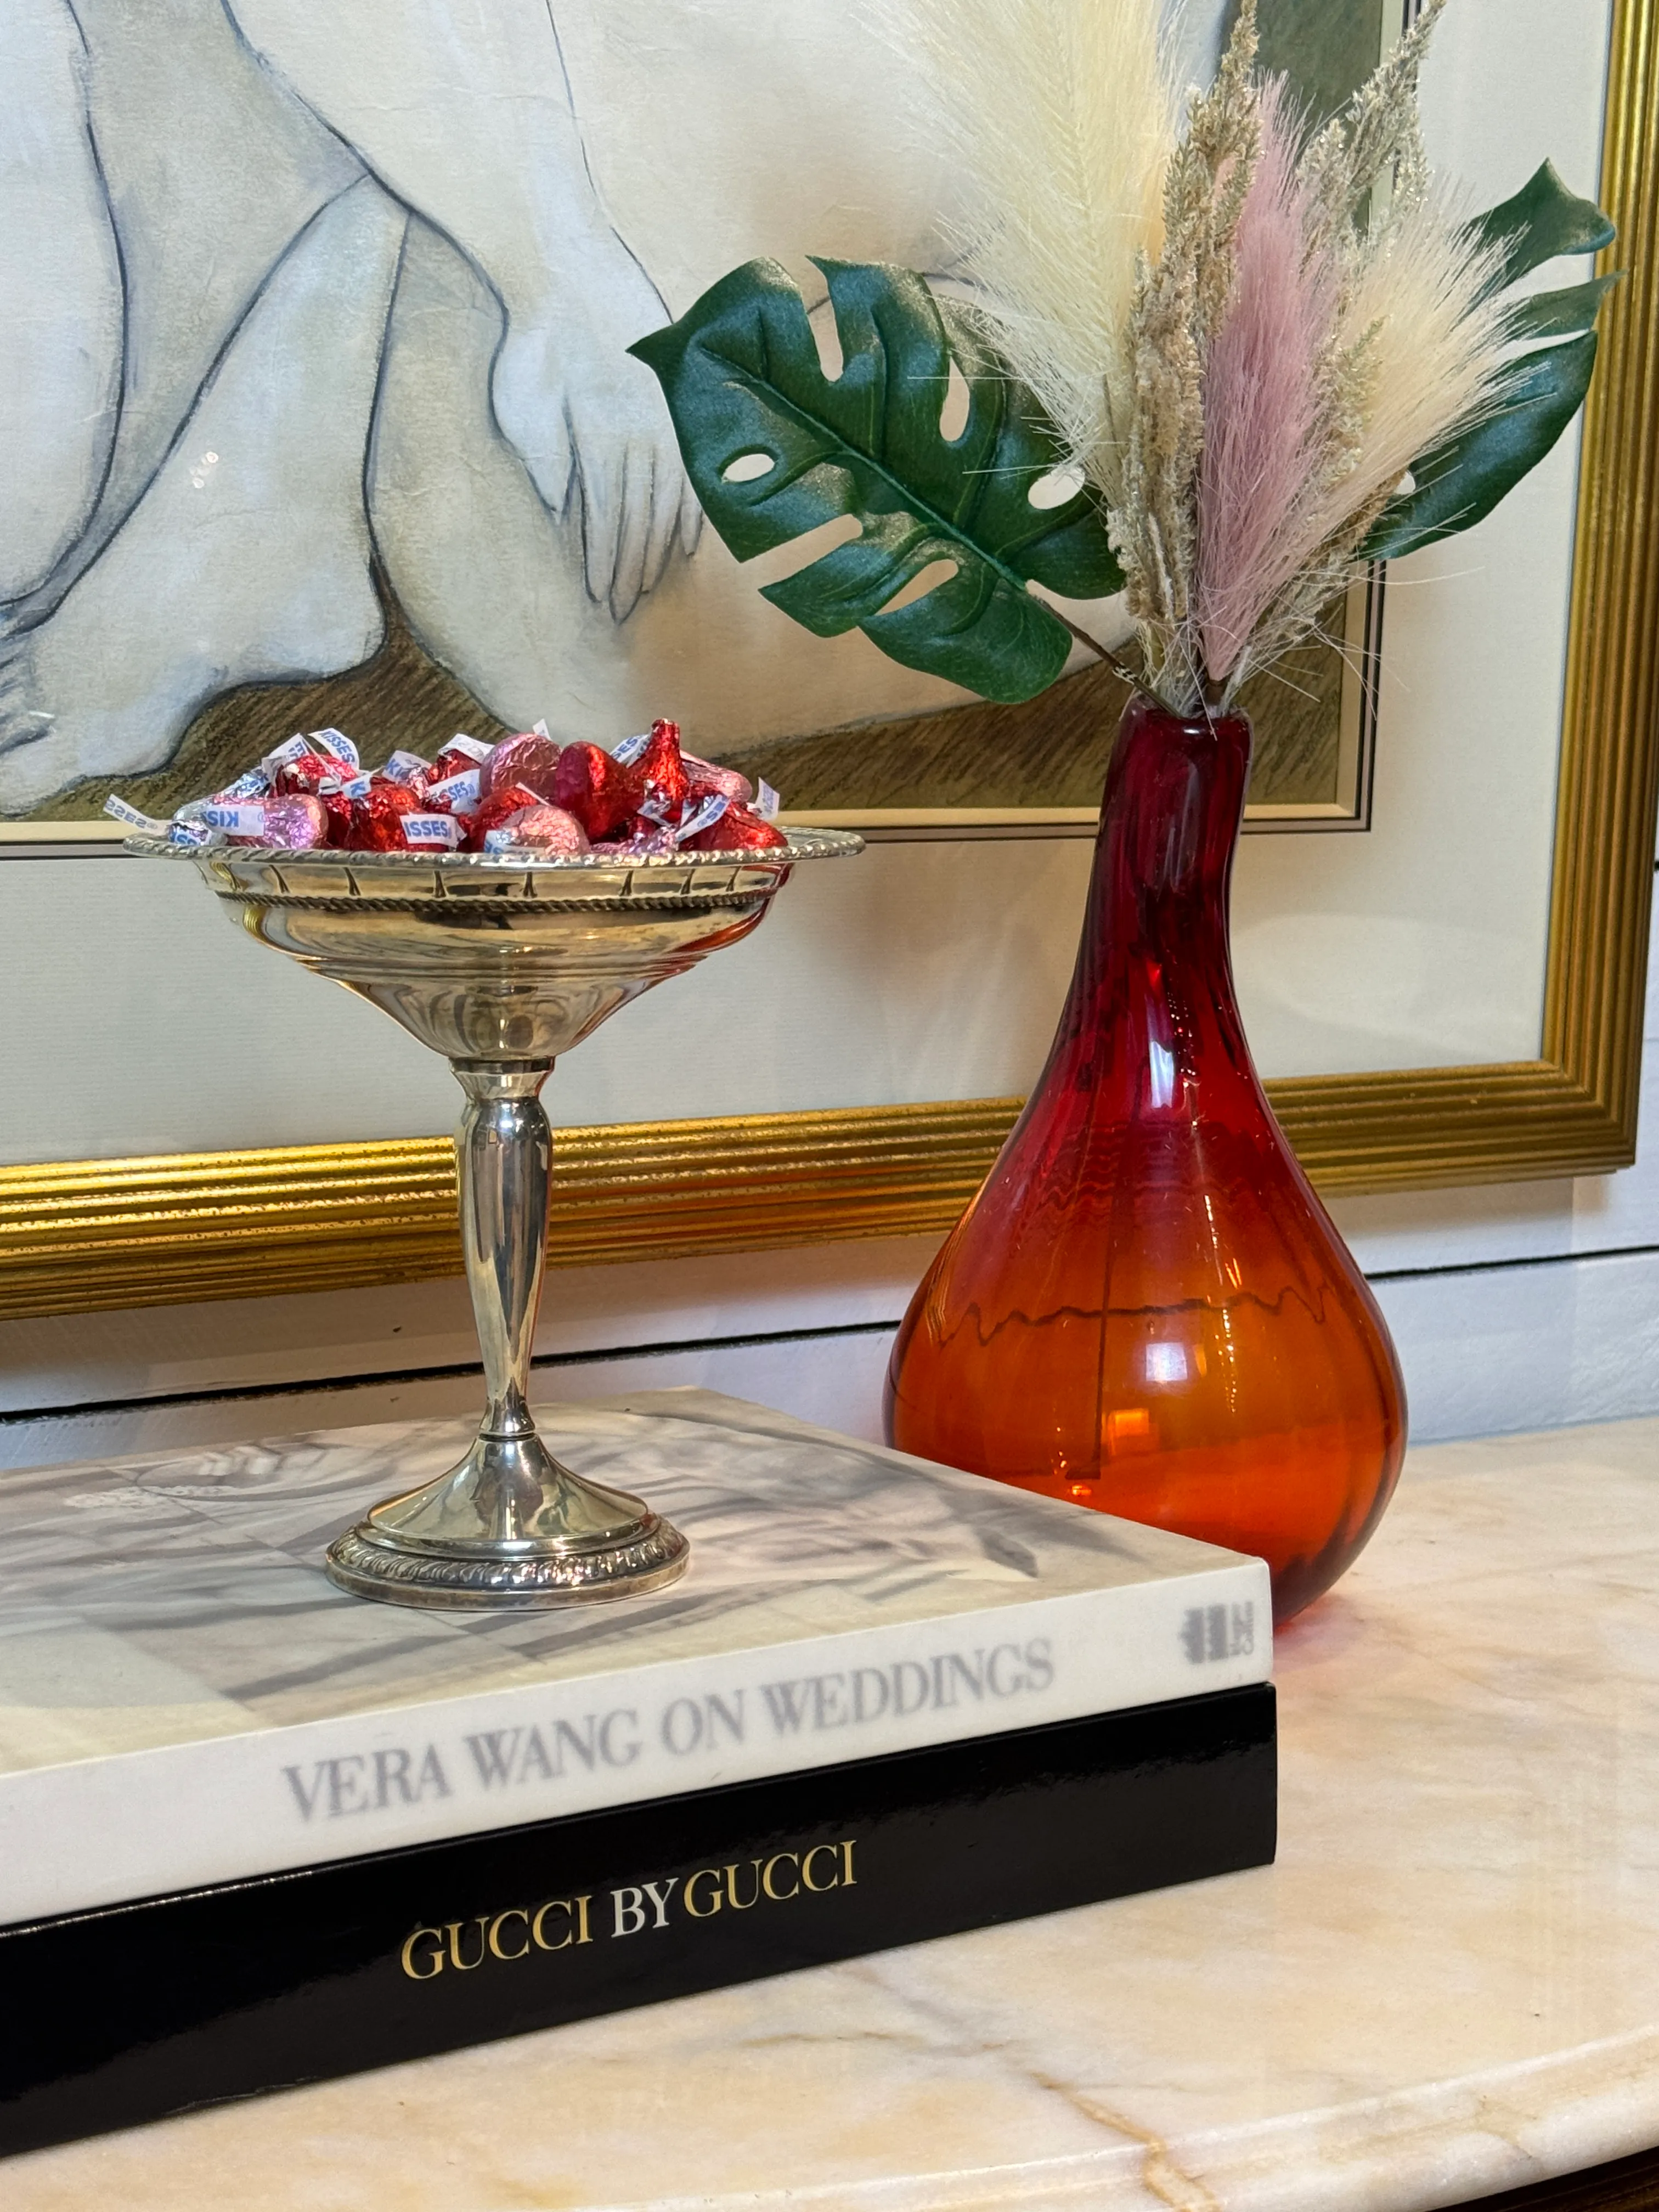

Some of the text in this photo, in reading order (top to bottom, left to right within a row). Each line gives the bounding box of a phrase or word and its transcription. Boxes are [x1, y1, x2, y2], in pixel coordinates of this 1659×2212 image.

[319, 731, 355, 764] KISSES
[281, 1636, 1056, 1822] VERA WANG ON WEDDINGS
[401, 1839, 858, 1979] GUCCI BY GUCCI
